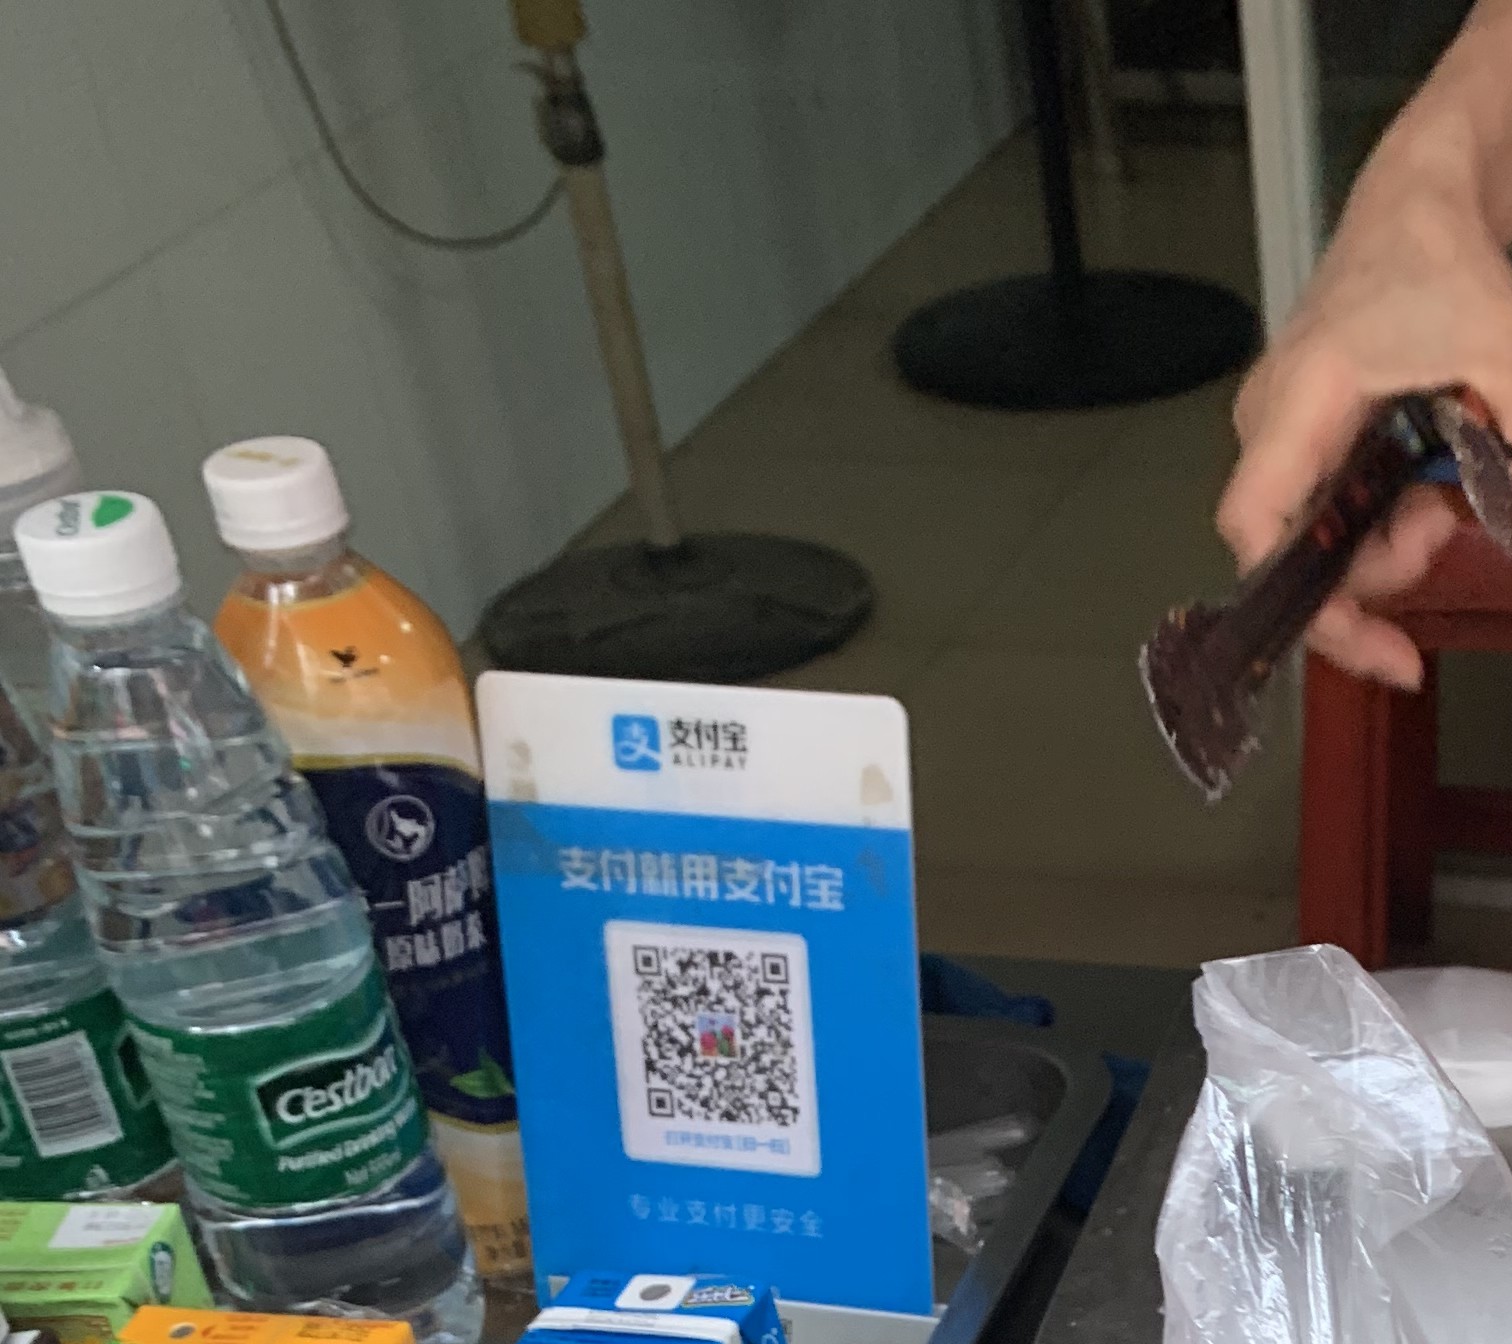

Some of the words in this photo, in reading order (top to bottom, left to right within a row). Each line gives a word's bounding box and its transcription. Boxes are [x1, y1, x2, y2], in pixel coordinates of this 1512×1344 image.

[668, 717, 749, 752] 支付宝
[672, 752, 748, 771] ALIPAY
[559, 847, 845, 912] 支付就用支付宝
[630, 1193, 824, 1239] 专业支付更安全
